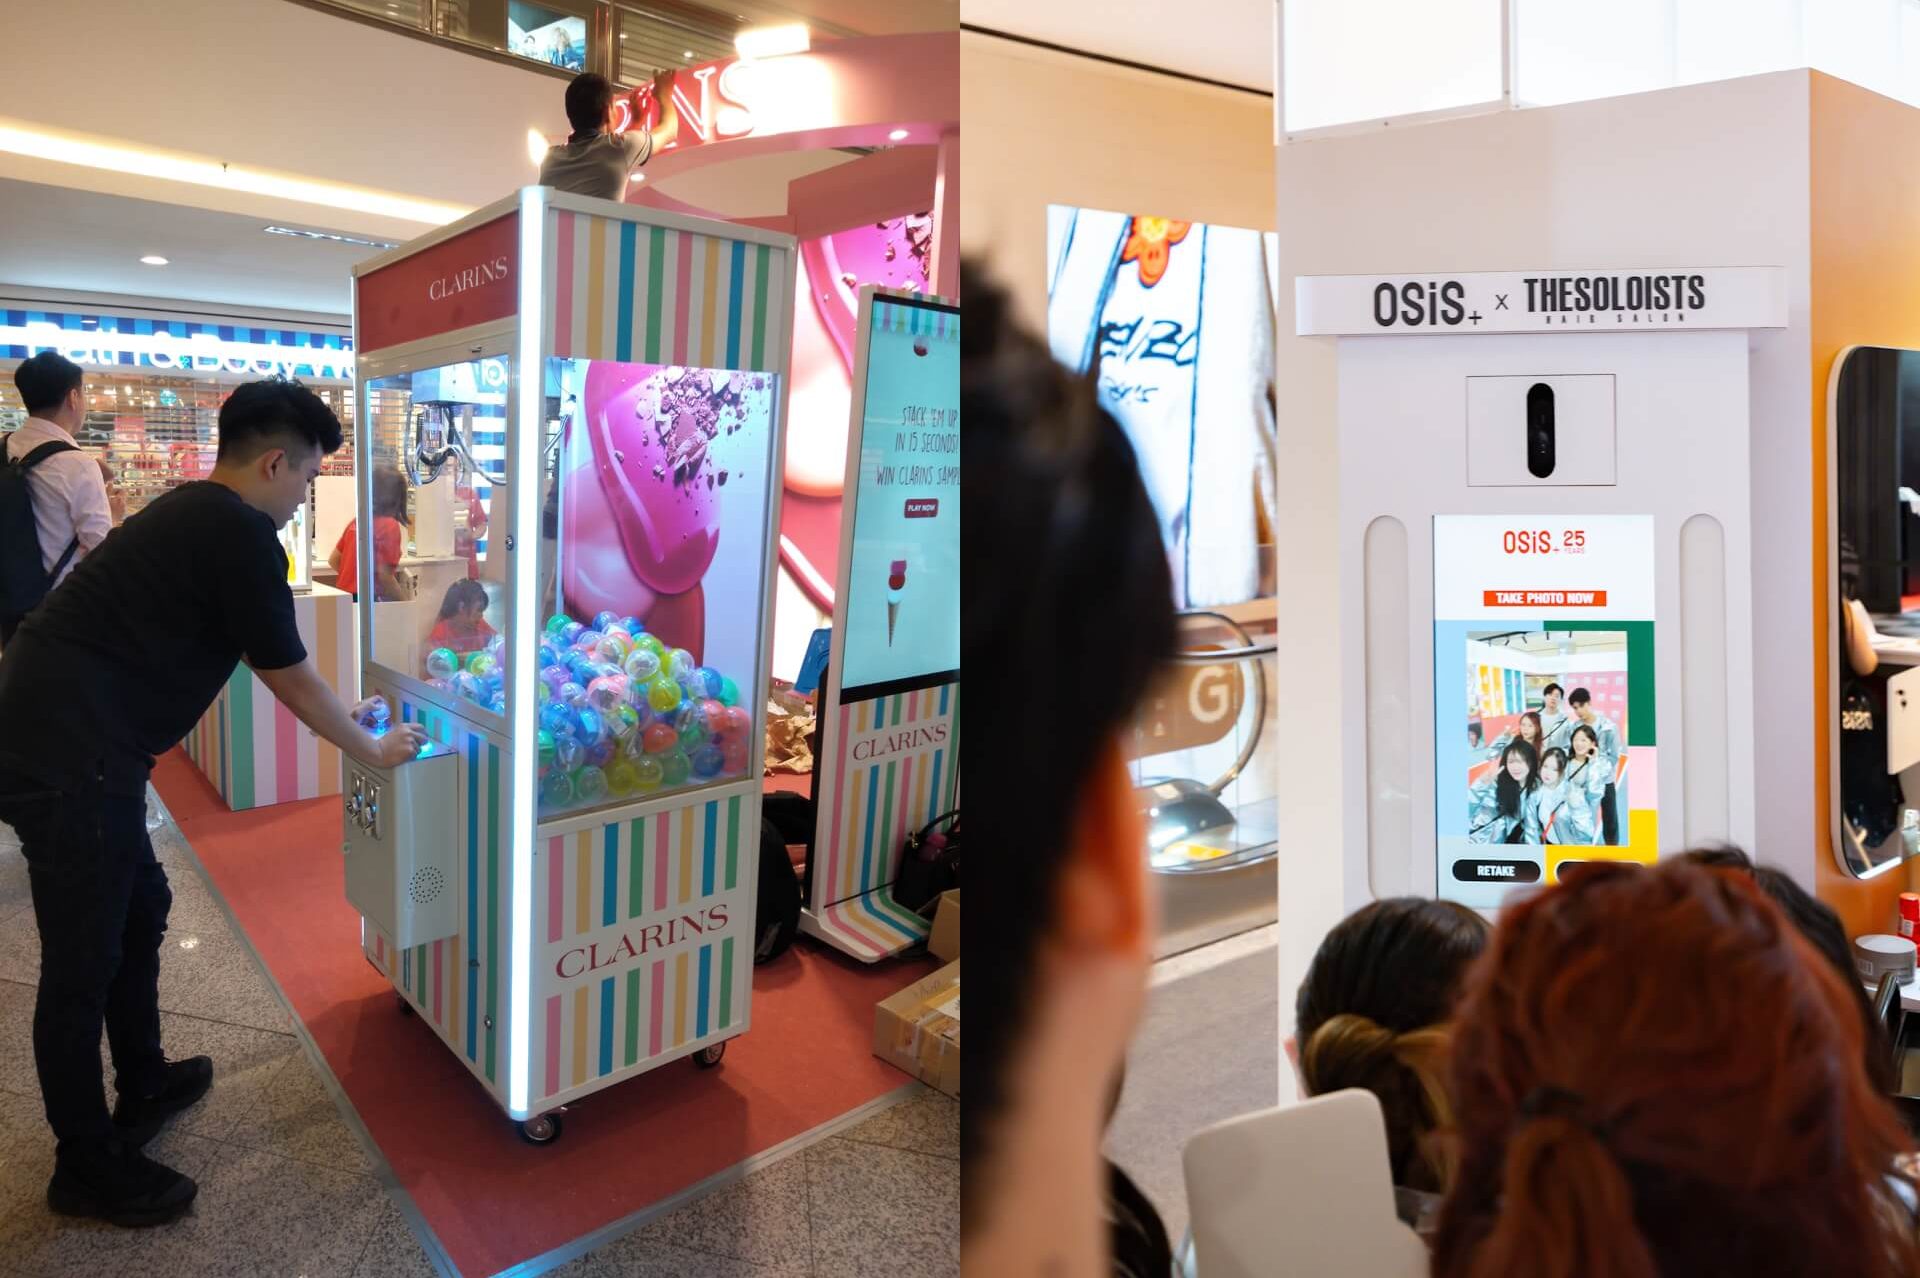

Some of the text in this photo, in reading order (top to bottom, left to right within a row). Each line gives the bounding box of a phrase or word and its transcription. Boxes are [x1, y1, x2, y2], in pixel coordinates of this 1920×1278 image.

[429, 256, 508, 301] CLARINS
[1523, 275, 1705, 312] THESOLOISTS
[901, 406, 927, 427] STACK
[948, 409, 959, 428] UP
[895, 432, 906, 452] IN
[908, 432, 919, 453] 15
[876, 466, 896, 486] WIN
[899, 465, 934, 486] CLARINS
[907, 504, 937, 512] PLAY NOW
[1563, 530, 1585, 547] 25
[1496, 592, 1595, 604] TAKE PHOTO NOW
[853, 723, 947, 761] CLARINS
[1477, 865, 1516, 877] RETAKE
[556, 904, 729, 979] CLARINS
